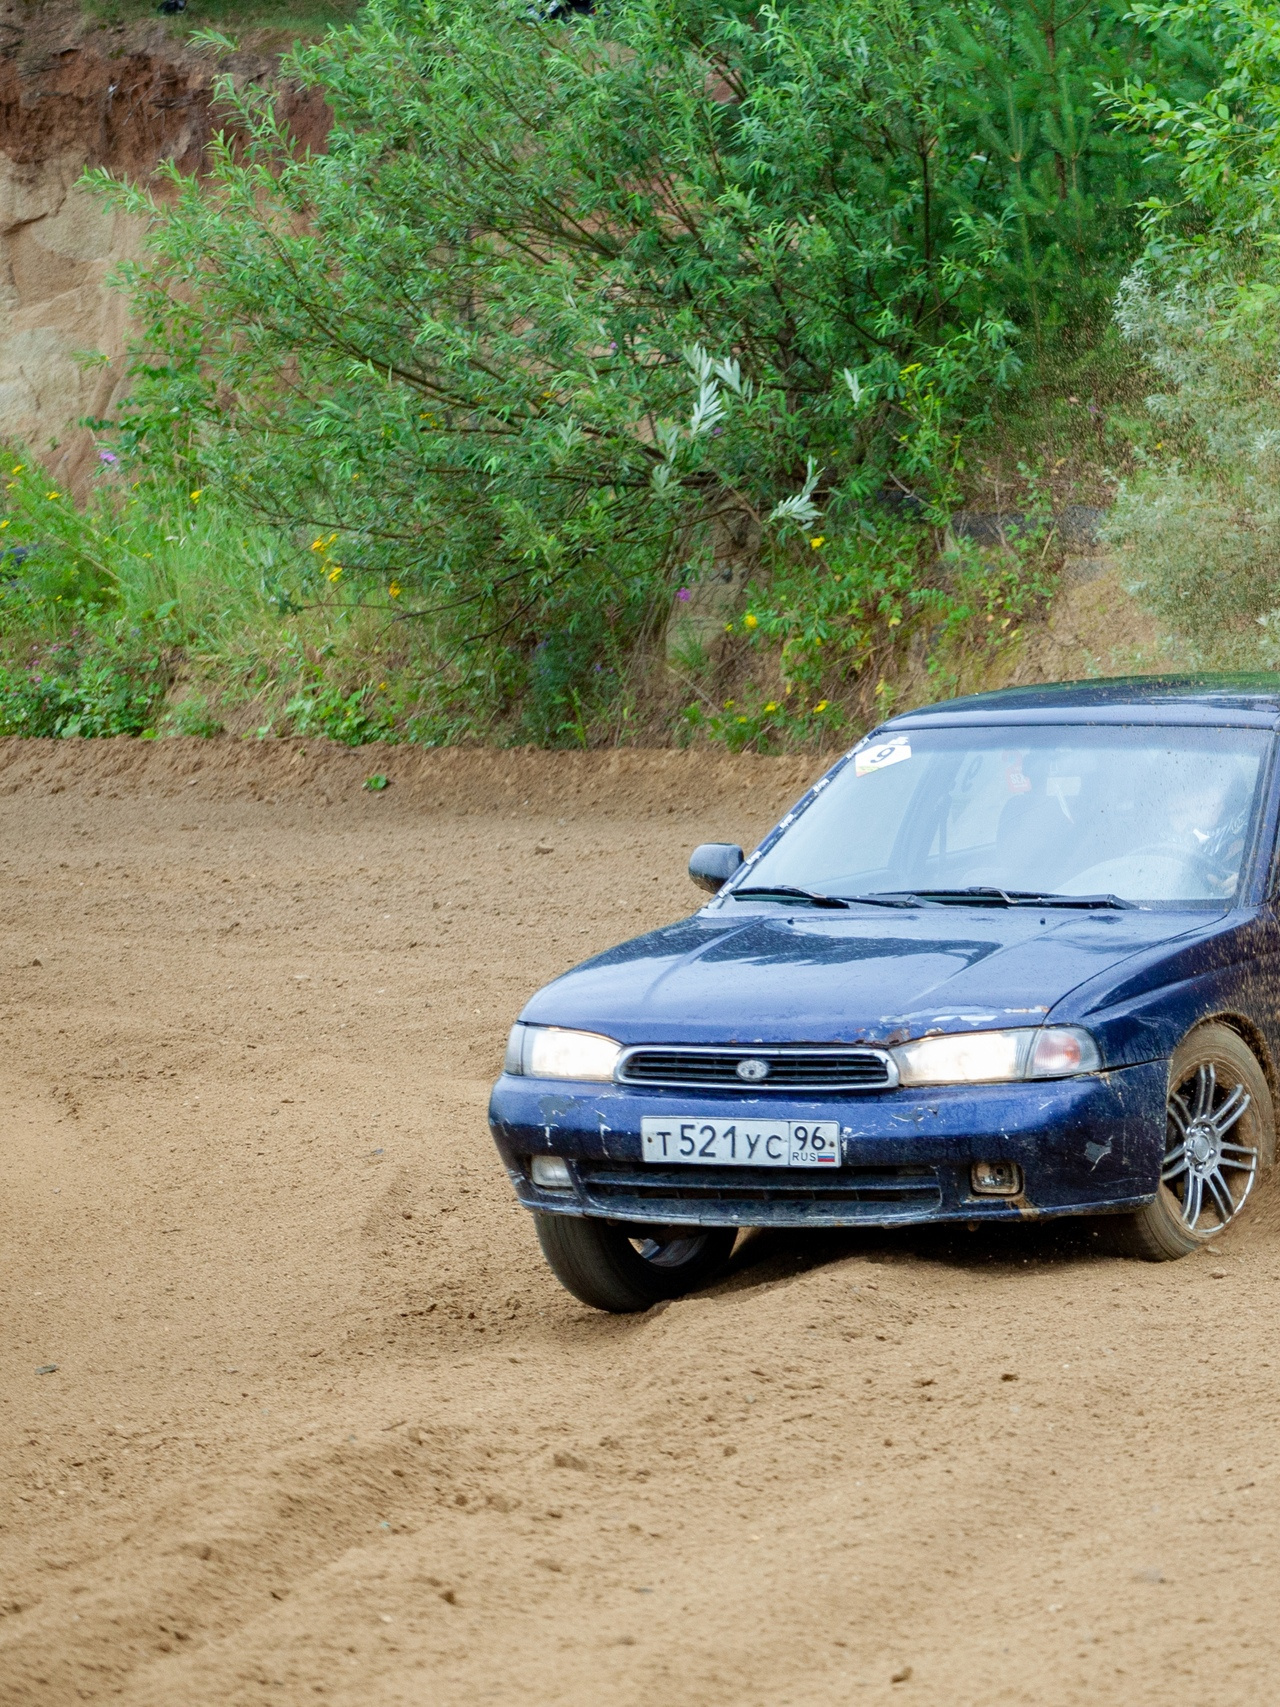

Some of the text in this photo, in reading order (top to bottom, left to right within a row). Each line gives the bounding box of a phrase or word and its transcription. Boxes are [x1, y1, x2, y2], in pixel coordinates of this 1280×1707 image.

[871, 748, 895, 763] 9
[794, 1126, 826, 1151] 96
[792, 1152, 816, 1162] RUS
